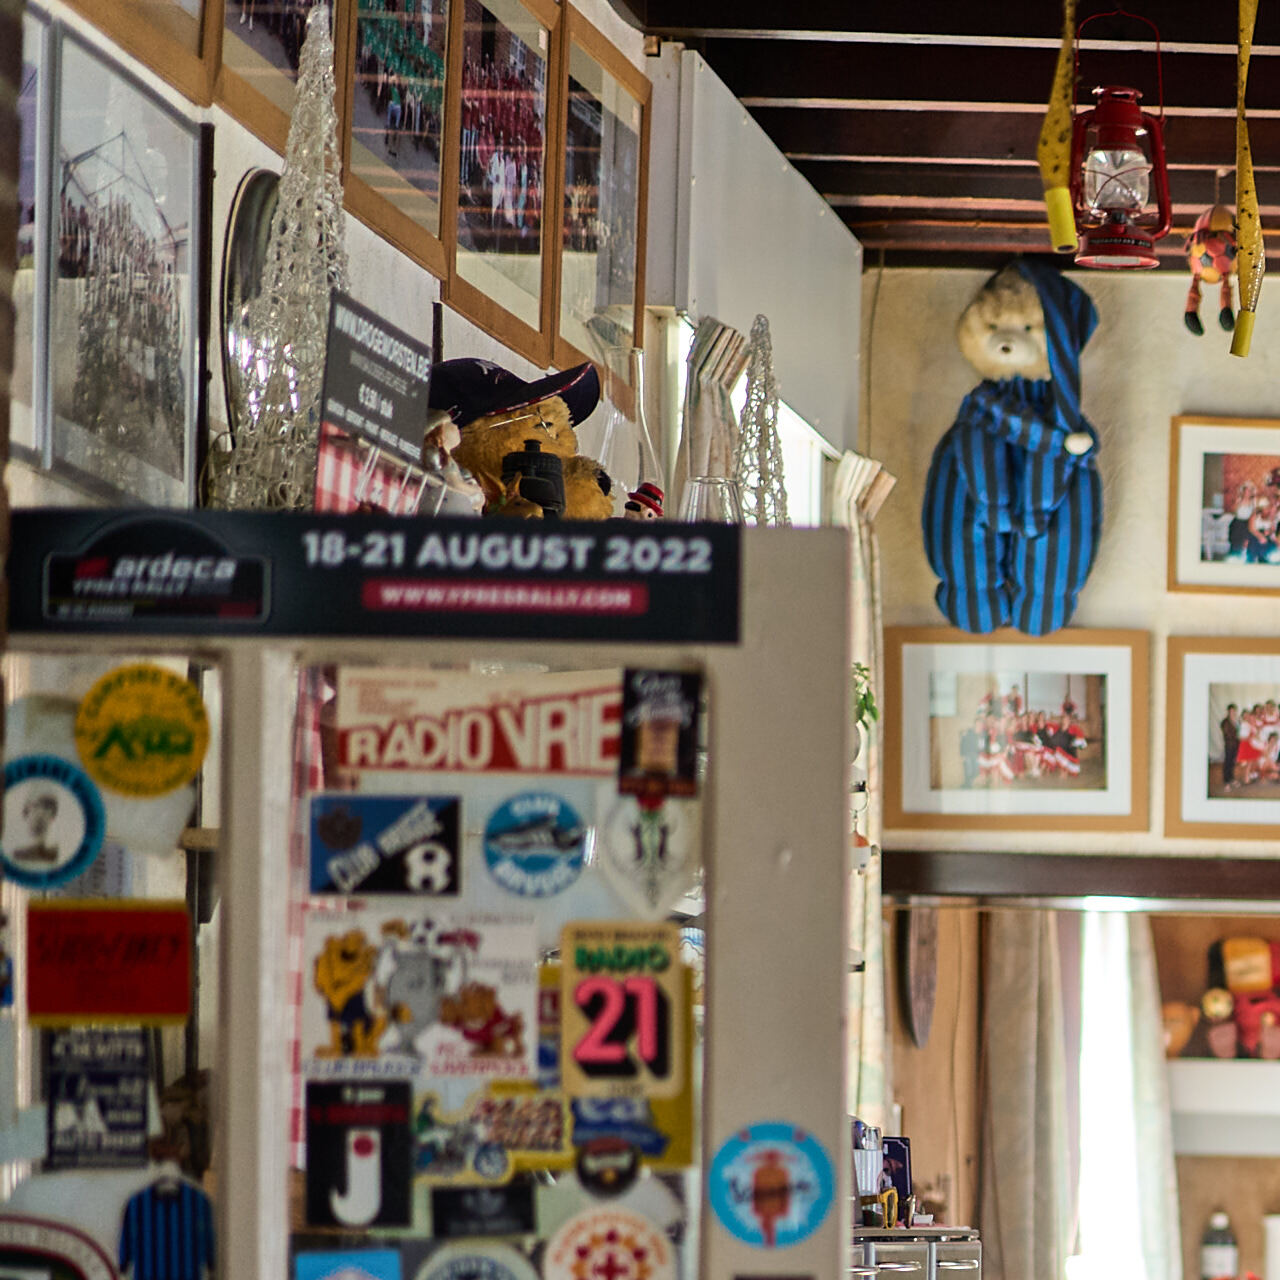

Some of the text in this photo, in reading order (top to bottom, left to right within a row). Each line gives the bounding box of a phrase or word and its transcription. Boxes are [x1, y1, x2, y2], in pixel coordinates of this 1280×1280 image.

[112, 550, 238, 579] ardeca
[302, 532, 713, 572] 18-21 AUGUST 2022
[347, 706, 495, 769] RADIO
[573, 944, 671, 973] RADIO
[572, 976, 661, 1064] 21
